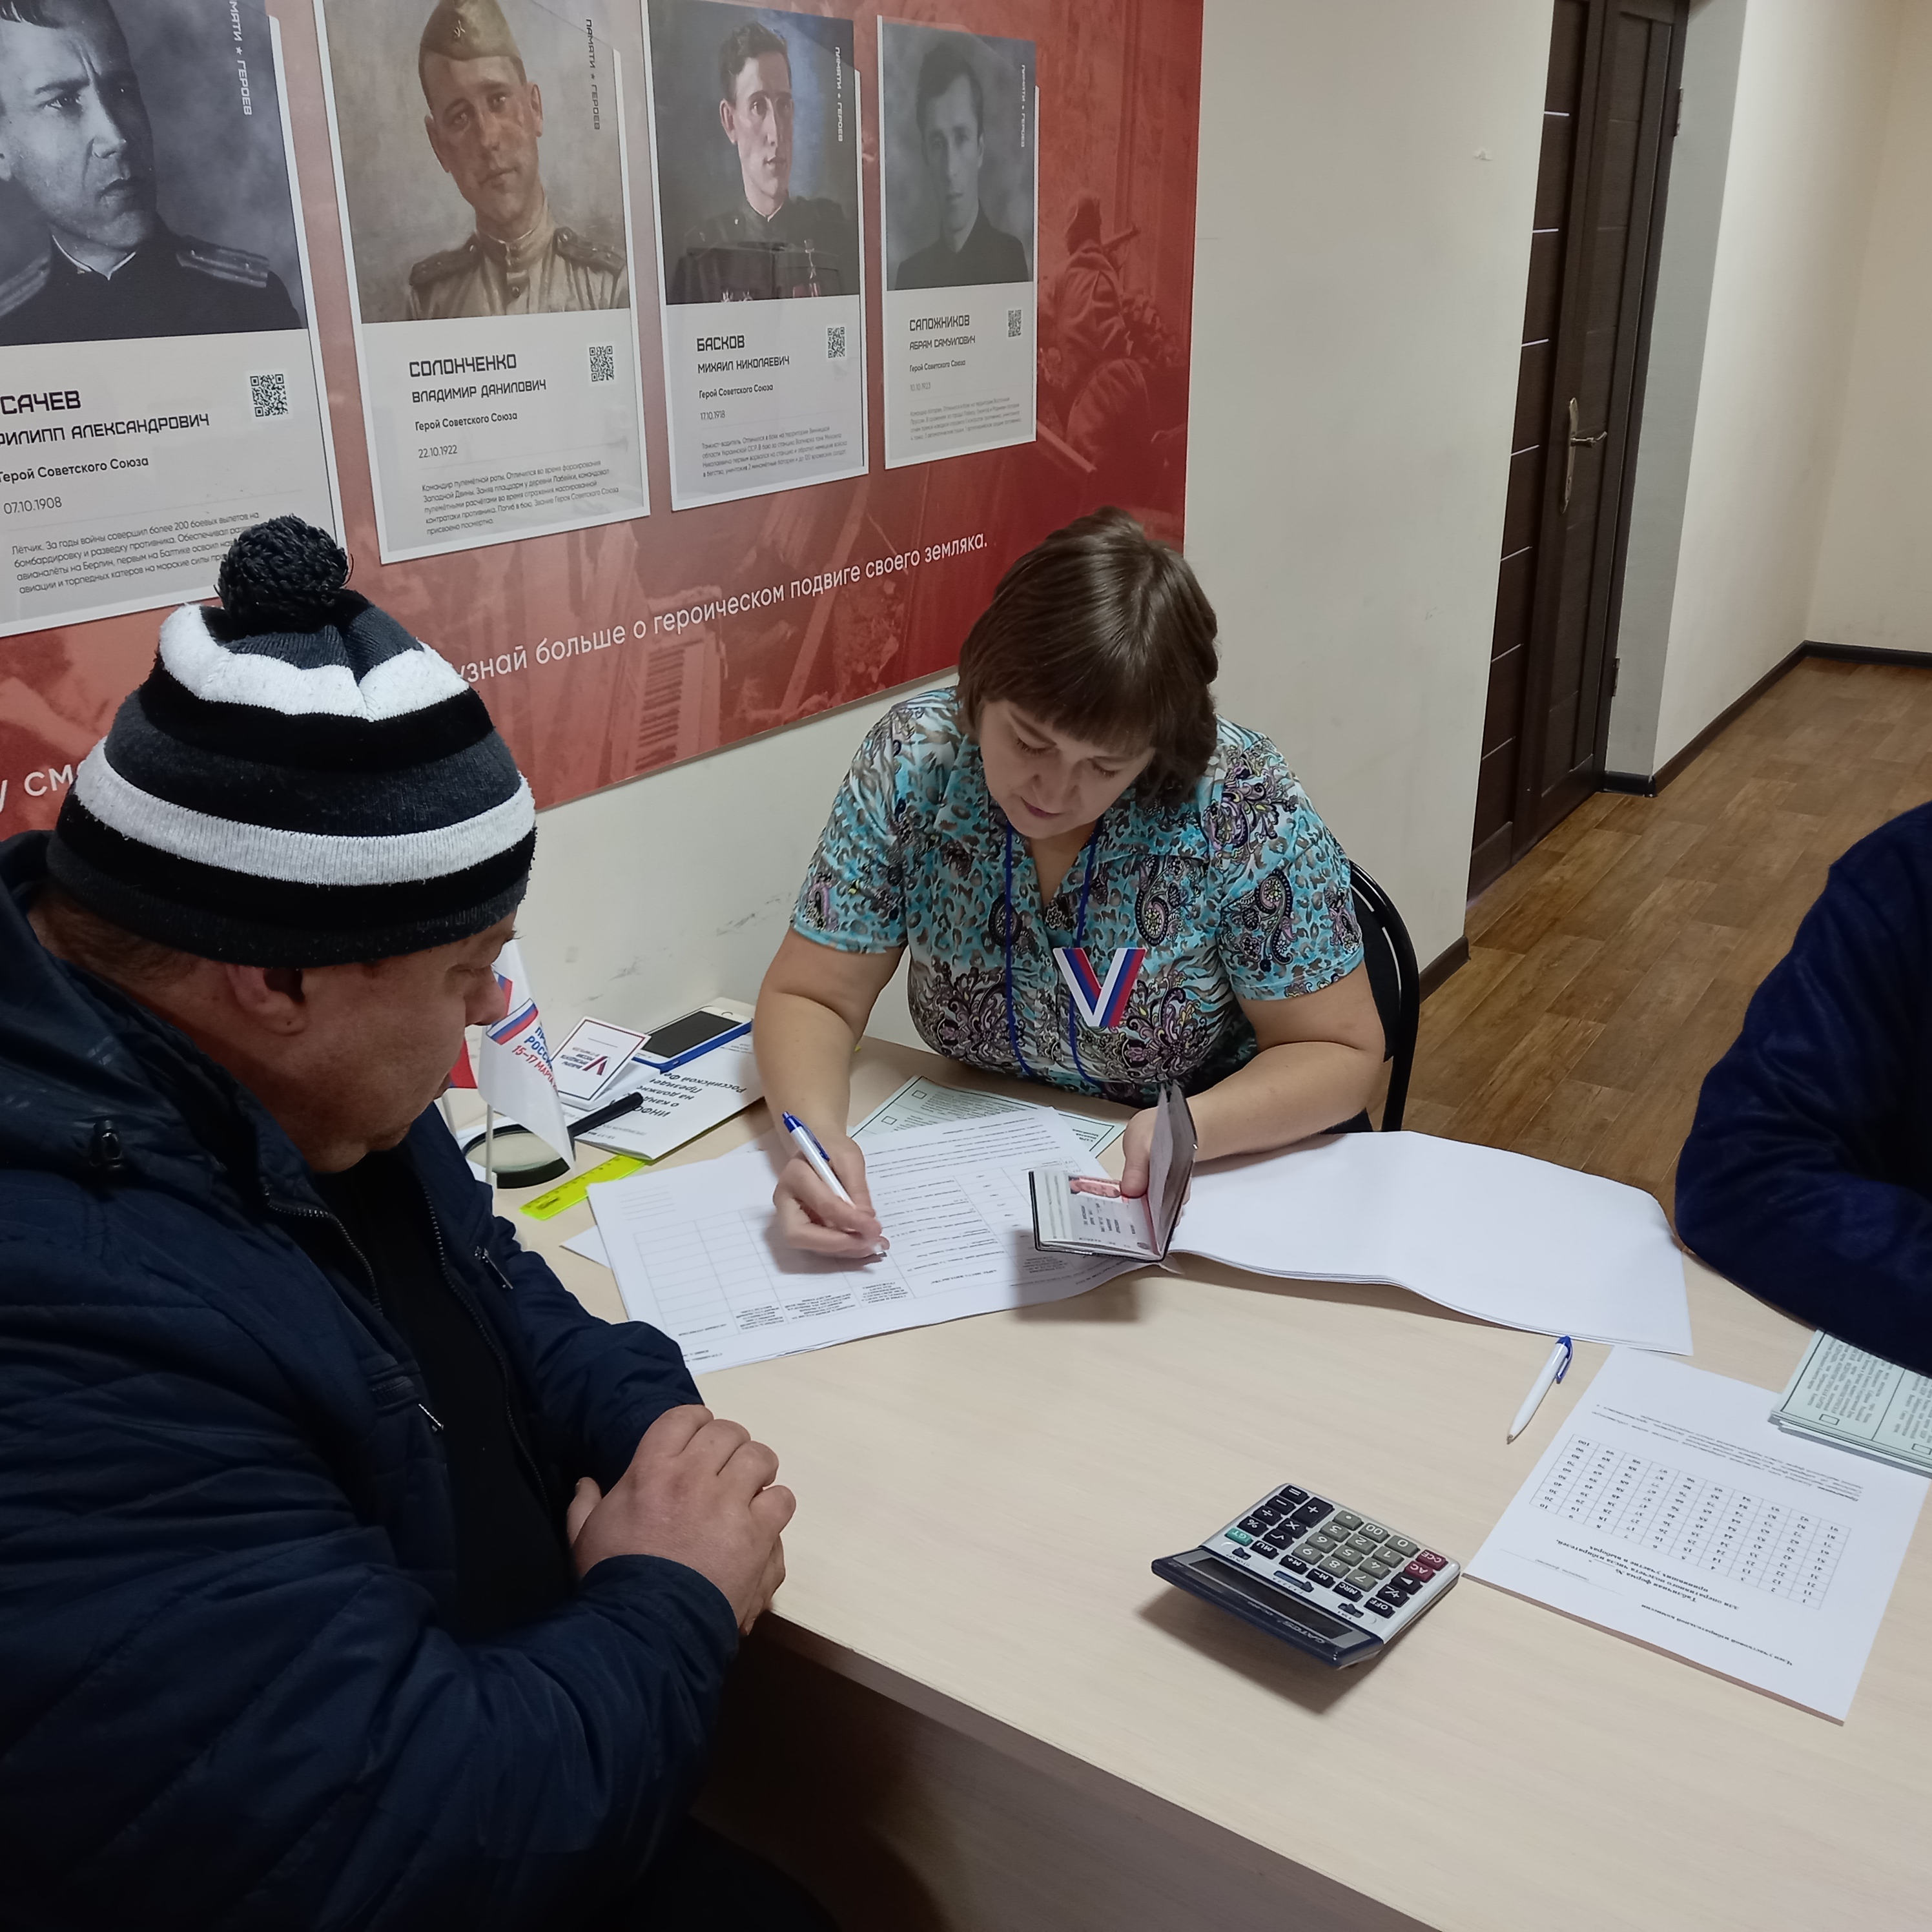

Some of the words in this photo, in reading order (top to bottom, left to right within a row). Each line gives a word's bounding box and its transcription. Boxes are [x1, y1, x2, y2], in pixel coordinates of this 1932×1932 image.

[229, 0, 243, 41] МЯТИ
[237, 59, 252, 116] ГЕРОЕВ
[586, 19, 596, 68] ПАМЯТИ
[591, 84, 601, 130] ГЕРОЕВ
[909, 314, 970, 332] САПОЖНИКОВ
[696, 334, 745, 352] БАСКОВ
[909, 339, 932, 351] АБРАМ
[934, 335, 976, 348] САМУИЛОВИЧ
[409, 353, 517, 378] СОЛОНЧЕНКО
[697, 360, 734, 374] МИХАИЛ
[736, 355, 790, 370] НИКОЛАЕВИЧ
[909, 364, 923, 373] Герой
[924, 361, 950, 371] Советского
[411, 385, 477, 403] ВЛАДИМИР
[480, 379, 547, 398] ДАНИЛОВИЧ
[699, 388, 717, 400] Герой
[718, 385, 753, 396] Советского
[754, 384, 774, 393] Союза
[71, 413, 210, 440] АЛЕКСАНДРОВИЧ
[415, 419, 441, 432] Герой
[442, 414, 489, 427] Советского
[491, 412, 518, 422] Союза
[418, 444, 458, 458] 22.10.1922
[37, 461, 108, 478] Советского
[110, 457, 149, 469] Союза
[3, 496, 63, 515] 07.10.1908
[45, 540, 57, 550] За
[59, 539, 79, 548] годы
[81, 535, 105, 545] войны
[107, 528, 148, 541] совершил
[149, 525, 173, 535] более
[174, 520, 189, 531] 200
[14, 552, 82, 568] бомбардировку
[90, 544, 128, 557] разведку
[116, 554, 147, 566] первым
[19, 581, 57, 594] авиации
[111, 566, 145, 578] катеров
[536, 624, 626, 666] больше
[633, 618, 647, 639] о
[653, 584, 785, 635] героическом
[790, 564, 861, 600] подвиге
[865, 548, 920, 579] своего
[925, 530, 989, 564] земляка.
[649, 1078, 703, 1094] Президе
[1231, 1530, 1248, 1539] GT
[1329, 1525, 1342, 1534] 3
[1365, 1525, 1384, 1536] 00
[1397, 1539, 1409, 1547] 0
[1355, 1536, 1367, 1545] 2
[1256, 1541, 1273, 1552] MU
[1342, 1548, 1355, 1557] 5
[1287, 1557, 1302, 1567] M+
[1329, 1559, 1341, 1568] 8
[1410, 1563, 1428, 1575] AC
[1338, 1582, 1359, 1596] MRC
[1369, 1599, 1389, 1610] OFF
[1653, 1583, 1697, 1603] Табличная
